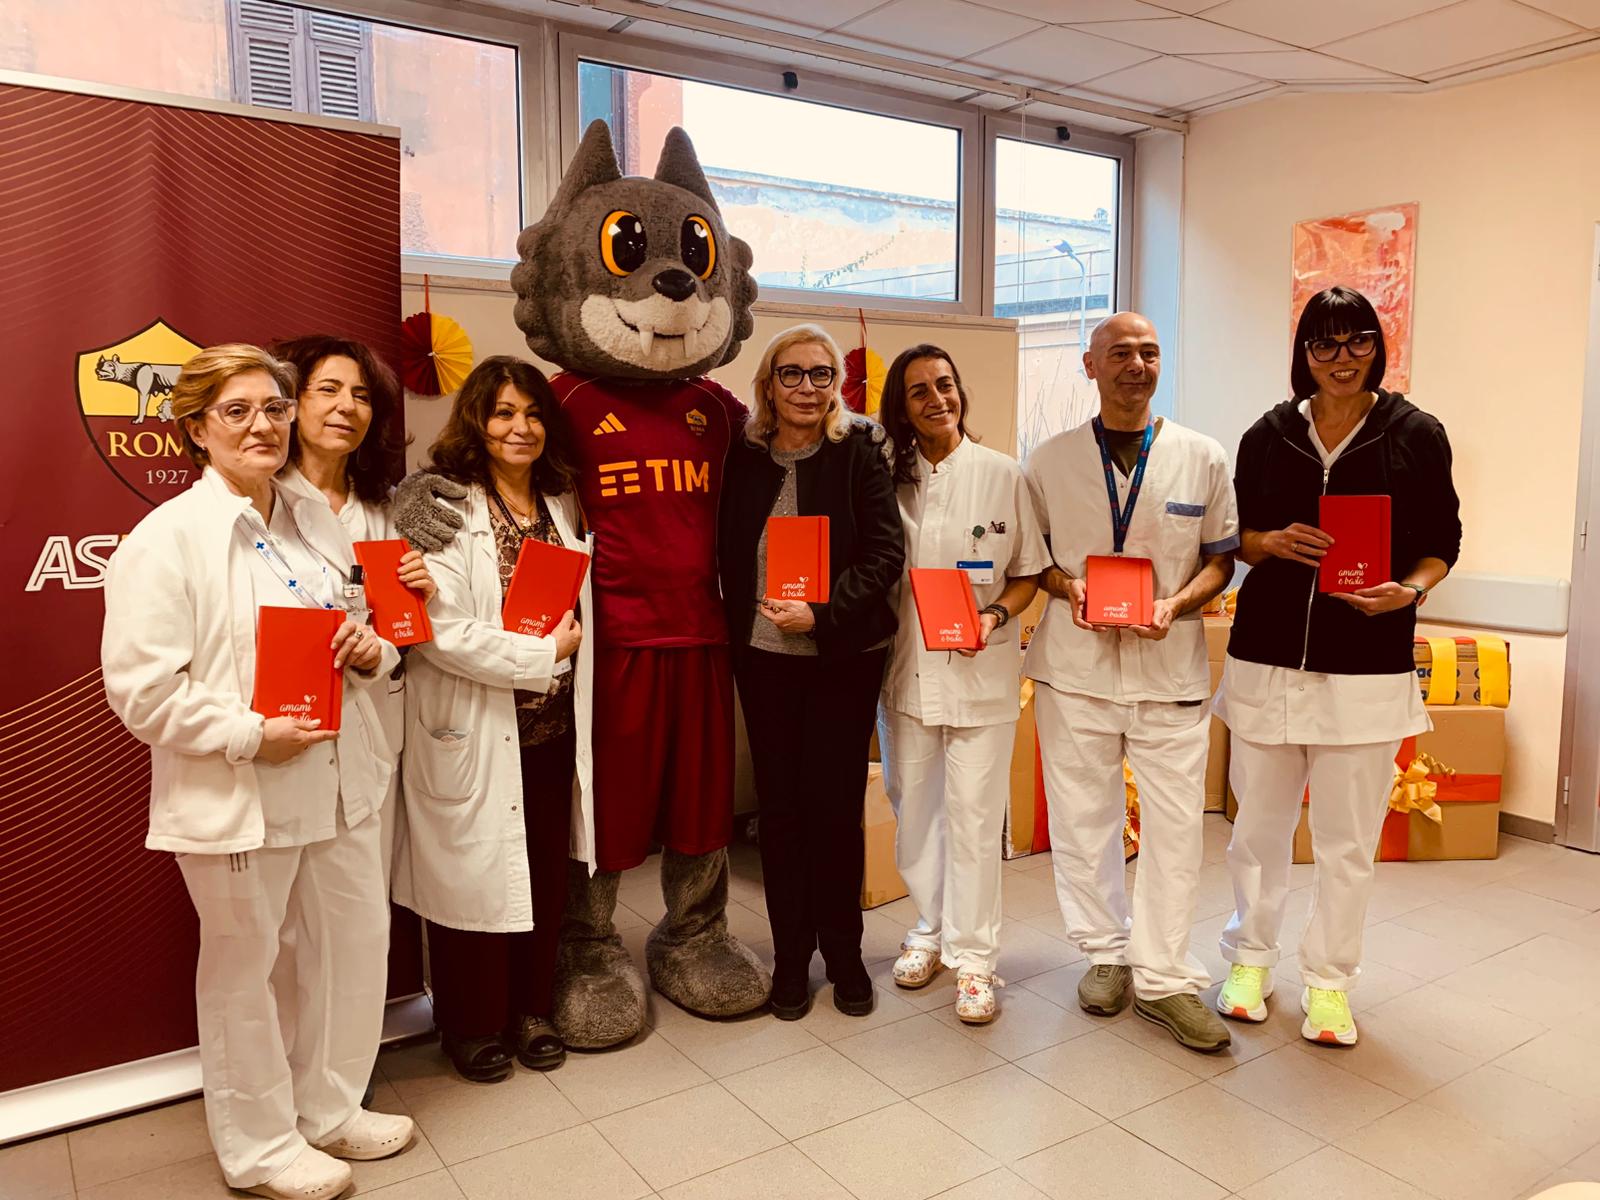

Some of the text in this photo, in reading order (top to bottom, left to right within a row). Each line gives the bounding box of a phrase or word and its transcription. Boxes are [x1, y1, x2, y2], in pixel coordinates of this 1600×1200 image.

[106, 431, 183, 457] ROM
[145, 469, 189, 485] 1927
[645, 459, 709, 493] TIM
[24, 534, 130, 592] AS
[1338, 569, 1364, 577] amami
[1344, 576, 1364, 585] basta
[787, 589, 806, 597] basta
[520, 617, 546, 628] amami
[523, 625, 543, 636] basta
[279, 703, 312, 712] amami
